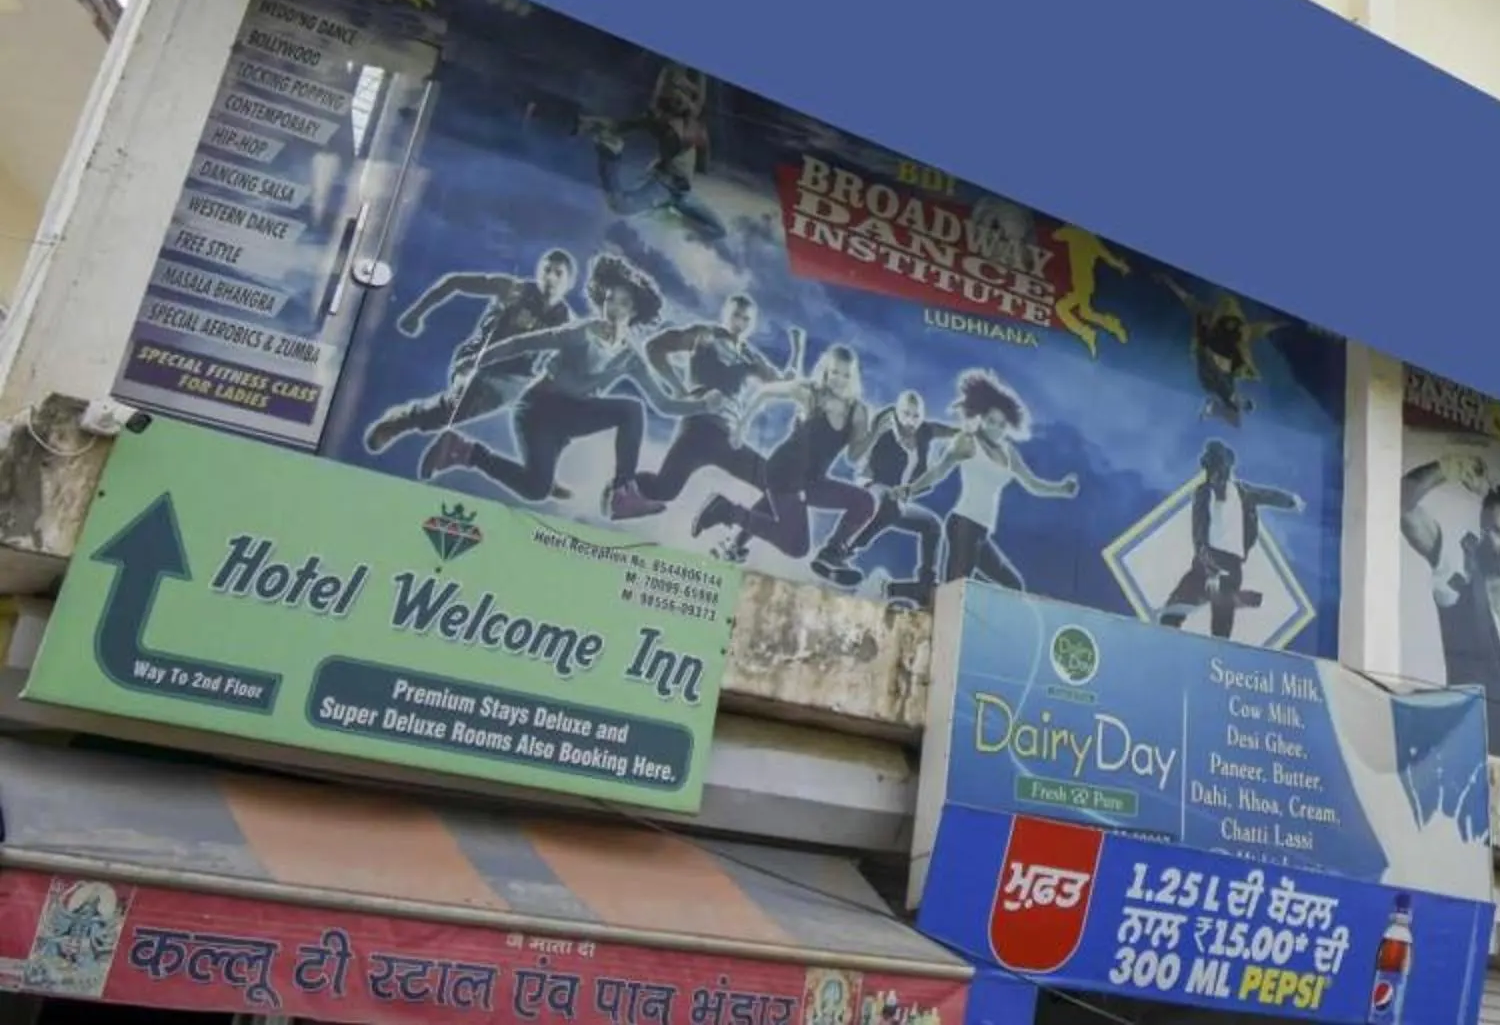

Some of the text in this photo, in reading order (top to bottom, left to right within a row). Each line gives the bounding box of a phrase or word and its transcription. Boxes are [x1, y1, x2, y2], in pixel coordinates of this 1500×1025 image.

[247, 30, 322, 66] BOLLYWOOD
[225, 94, 321, 137] CONTEMPORARY
[211, 128, 268, 156] HIP-HOP
[200, 160, 295, 203] DANCING SALSA
[188, 196, 289, 240] WESTERN DANCE
[798, 154, 1054, 278] BROADWAY
[174, 230, 243, 263] FREE STYLE
[795, 188, 1055, 305] DANCE
[161, 267, 275, 312] MASALA BHANGRA
[789, 213, 1051, 327] INSTITUTE
[148, 302, 321, 366] SPECIAL AEROBICS & ZUMBA
[924, 308, 1038, 348] LUDHIANA
[137, 346, 318, 402] SPECIAL FITNESS CLASS
[178, 375, 271, 408] FOR LADIES
[212, 534, 704, 703] Hotel Welcome Inn
[134, 659, 264, 699] Way To 2nd Floor
[1210, 656, 1274, 694] Special
[392, 678, 630, 745] Premium Stays Deluxe and
[1228, 694, 1263, 720] Cow
[319, 696, 677, 782] Super Deluxe Rooms Also Booking Here.
[1226, 723, 1260, 750] Desi
[1031, 781, 1124, 811] Fresh & Pure
[1221, 816, 1313, 850] Chatti Lassi
[1126, 862, 1203, 907] 1.25
[1203, 875, 1220, 912] L
[1227, 869, 1265, 919] ਦੀ
[1117, 906, 1188, 950] ਨਾਲ
[1314, 926, 1350, 974] ਦੀ
[130, 926, 282, 1010] कल्लू
[293, 929, 352, 997] टी
[369, 952, 499, 1011] स्टाल
[594, 975, 677, 1025] पान
[1109, 946, 1326, 1010] 300 ML PEPSI
